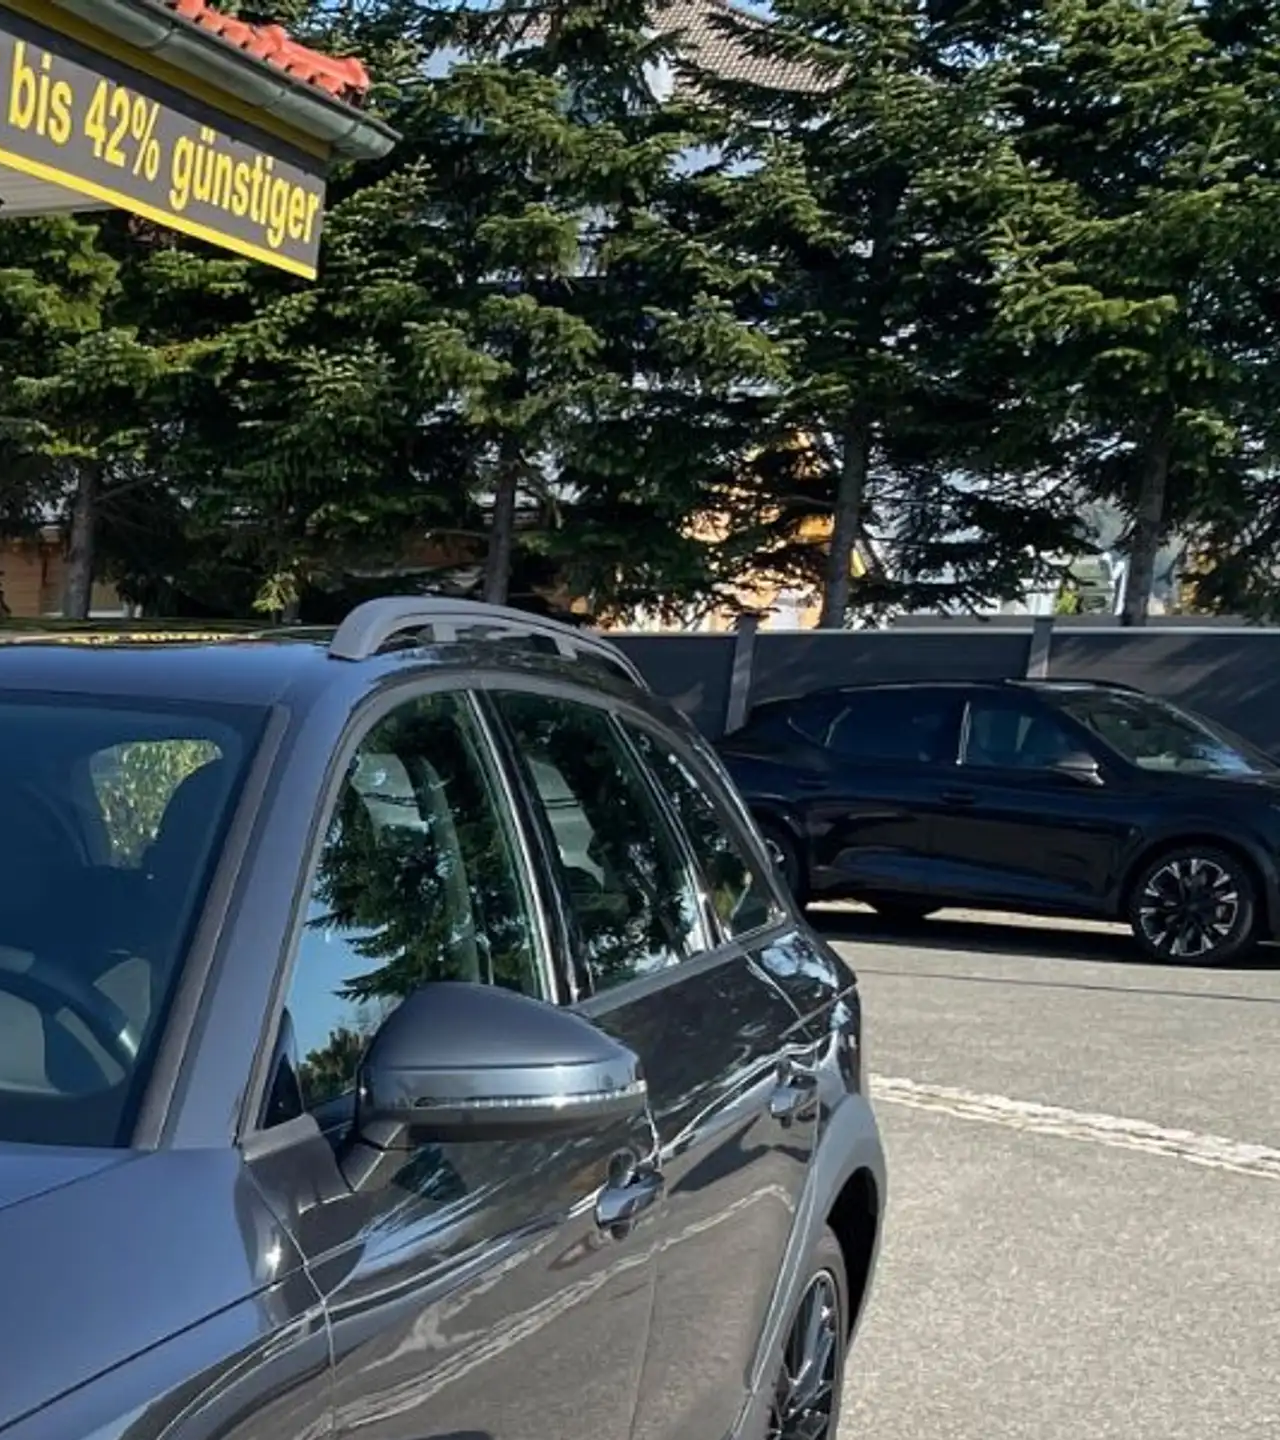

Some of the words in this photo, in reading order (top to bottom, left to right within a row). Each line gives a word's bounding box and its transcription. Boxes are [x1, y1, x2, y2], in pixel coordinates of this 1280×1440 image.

[9, 40, 73, 144] bis
[84, 79, 161, 182] 42%
[169, 126, 321, 248] günstiger
